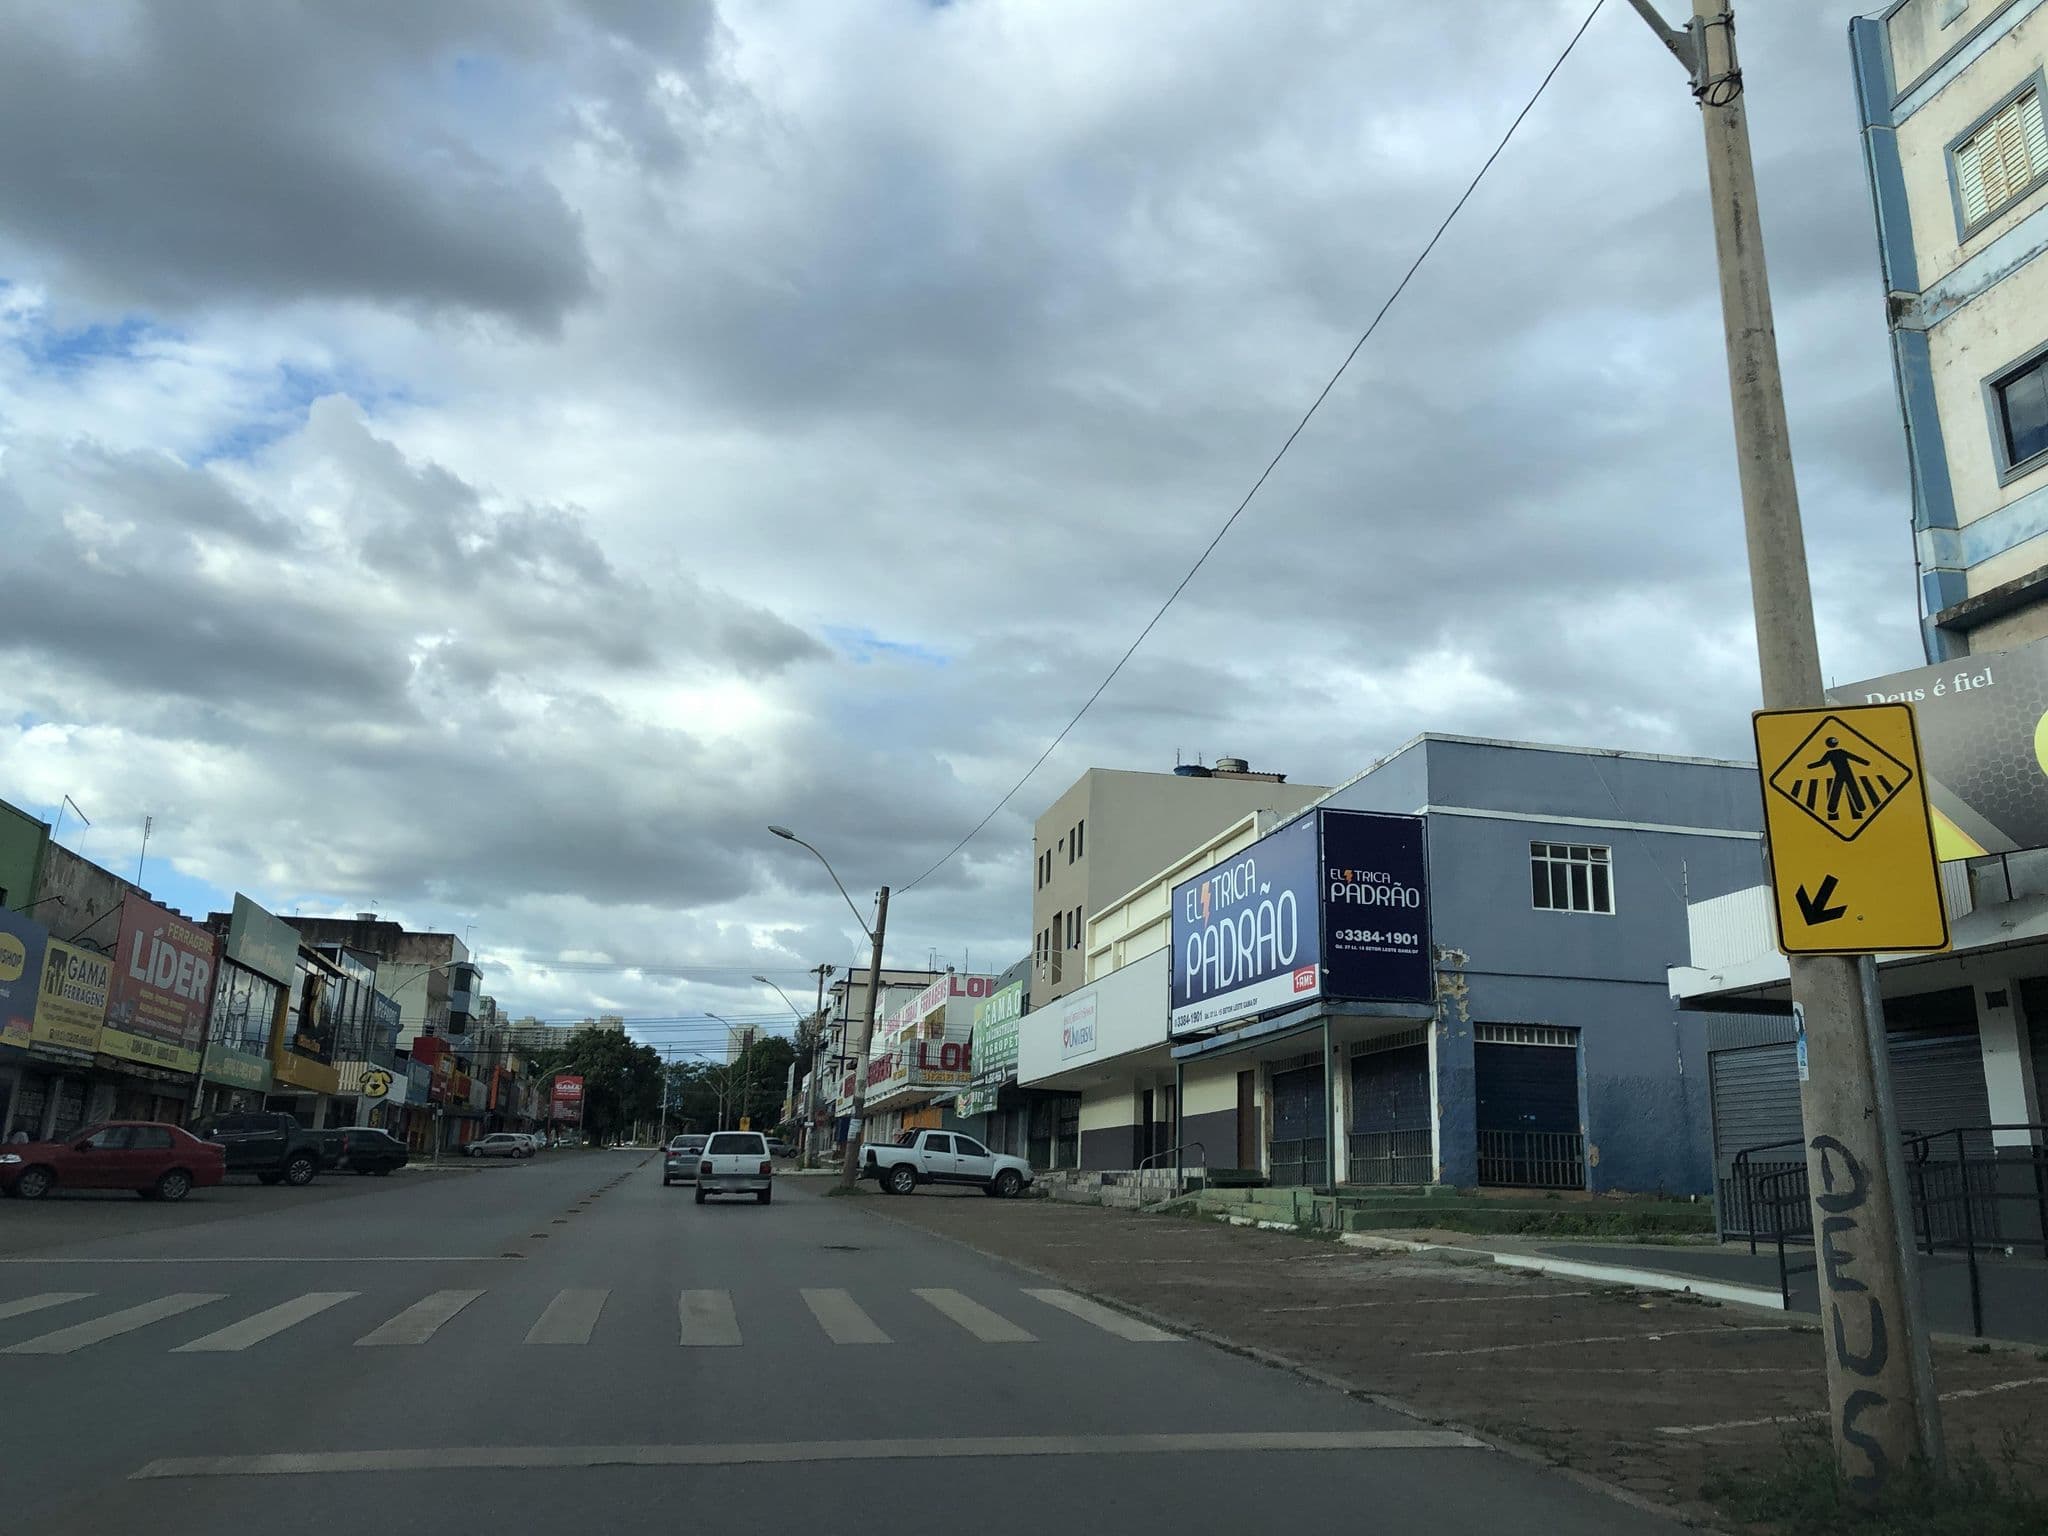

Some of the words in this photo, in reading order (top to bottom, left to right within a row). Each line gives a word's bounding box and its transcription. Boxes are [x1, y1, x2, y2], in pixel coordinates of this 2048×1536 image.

[1933, 677, 1946, 697] é
[1952, 667, 1995, 693] fiel
[1330, 881, 1420, 908] PADRÃO
[168, 922, 215, 956] FERRAGENS
[1186, 881, 1298, 999] PADRÃO
[1344, 929, 1418, 946] 3384-1901
[67, 955, 108, 990] GAMA
[129, 927, 210, 1004] LÍDER
[1295, 972, 1314, 988] FAME
[62, 983, 106, 1008] FERRAGENS
[985, 987, 1020, 1028] GAMÃO
[1810, 1134, 1888, 1494] DEUS
